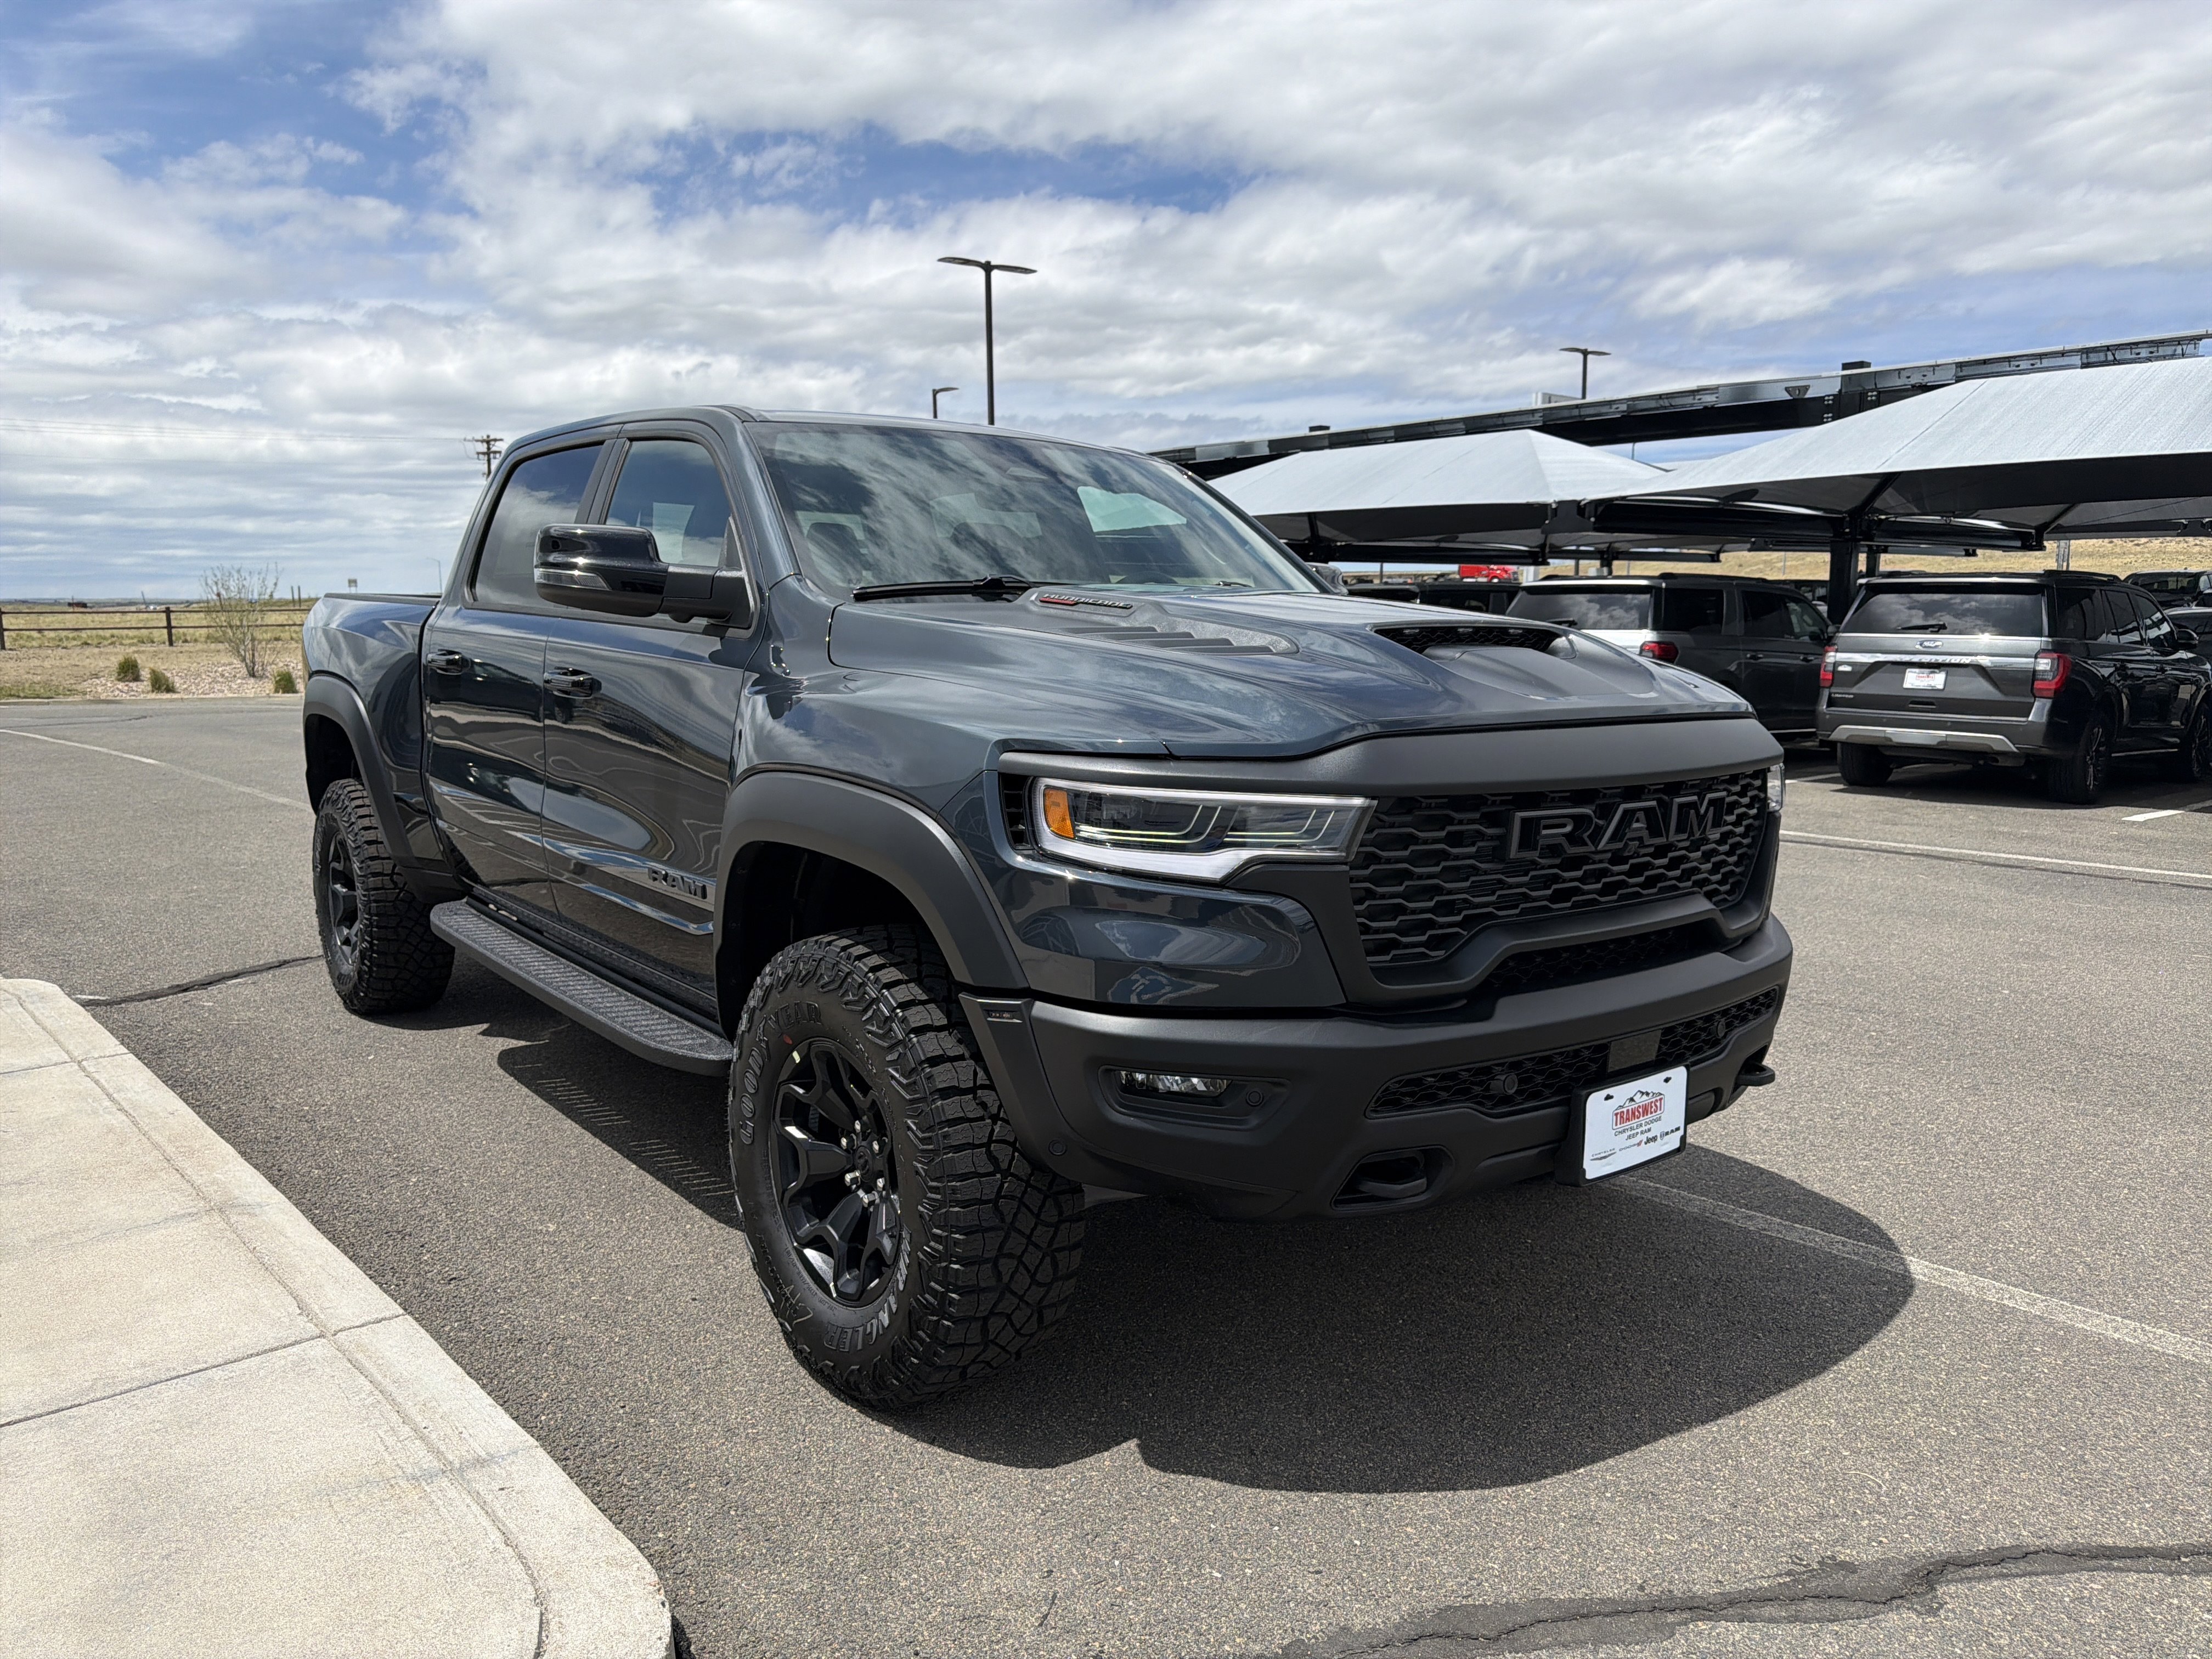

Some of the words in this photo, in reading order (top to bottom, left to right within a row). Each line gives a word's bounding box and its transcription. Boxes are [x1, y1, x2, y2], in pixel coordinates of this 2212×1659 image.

[1043, 594, 1132, 608] HURRICANE
[1510, 791, 1728, 859] RAM
[648, 867, 707, 899] RAM
[1614, 1097, 1663, 1127] TRANSWEST
[1614, 1123, 1643, 1137] CHRYSLER
[1644, 1116, 1662, 1127] DODGE
[1626, 1132, 1639, 1141] JEEP
[1640, 1127, 1652, 1136] RAM
[1644, 1135, 1658, 1146] Jeep
[1664, 1126, 1680, 1136] RAM
